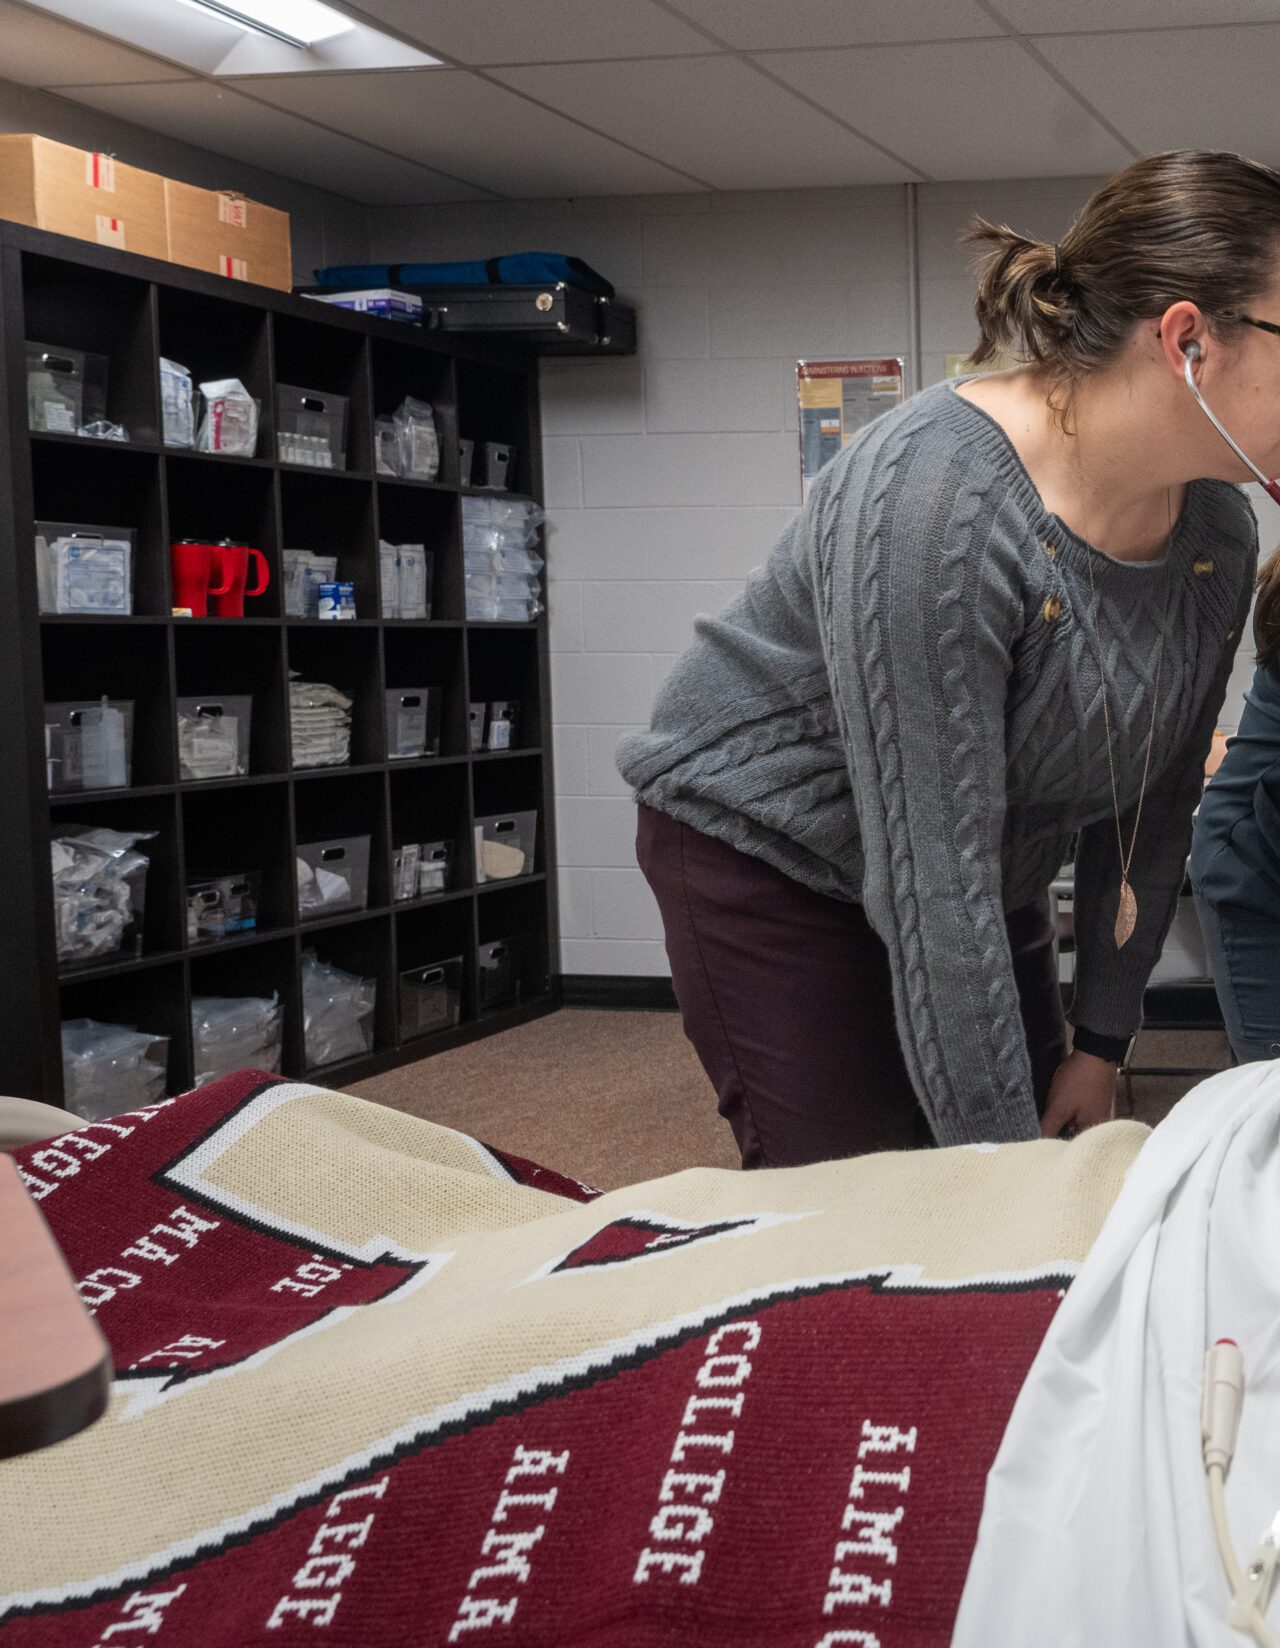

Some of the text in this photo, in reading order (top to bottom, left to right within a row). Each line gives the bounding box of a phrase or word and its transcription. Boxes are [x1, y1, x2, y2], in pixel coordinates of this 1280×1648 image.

[448, 1445, 570, 1643] ALMA
[633, 1321, 761, 1584] COLLEGE
[823, 1420, 917, 1614] ALMA
